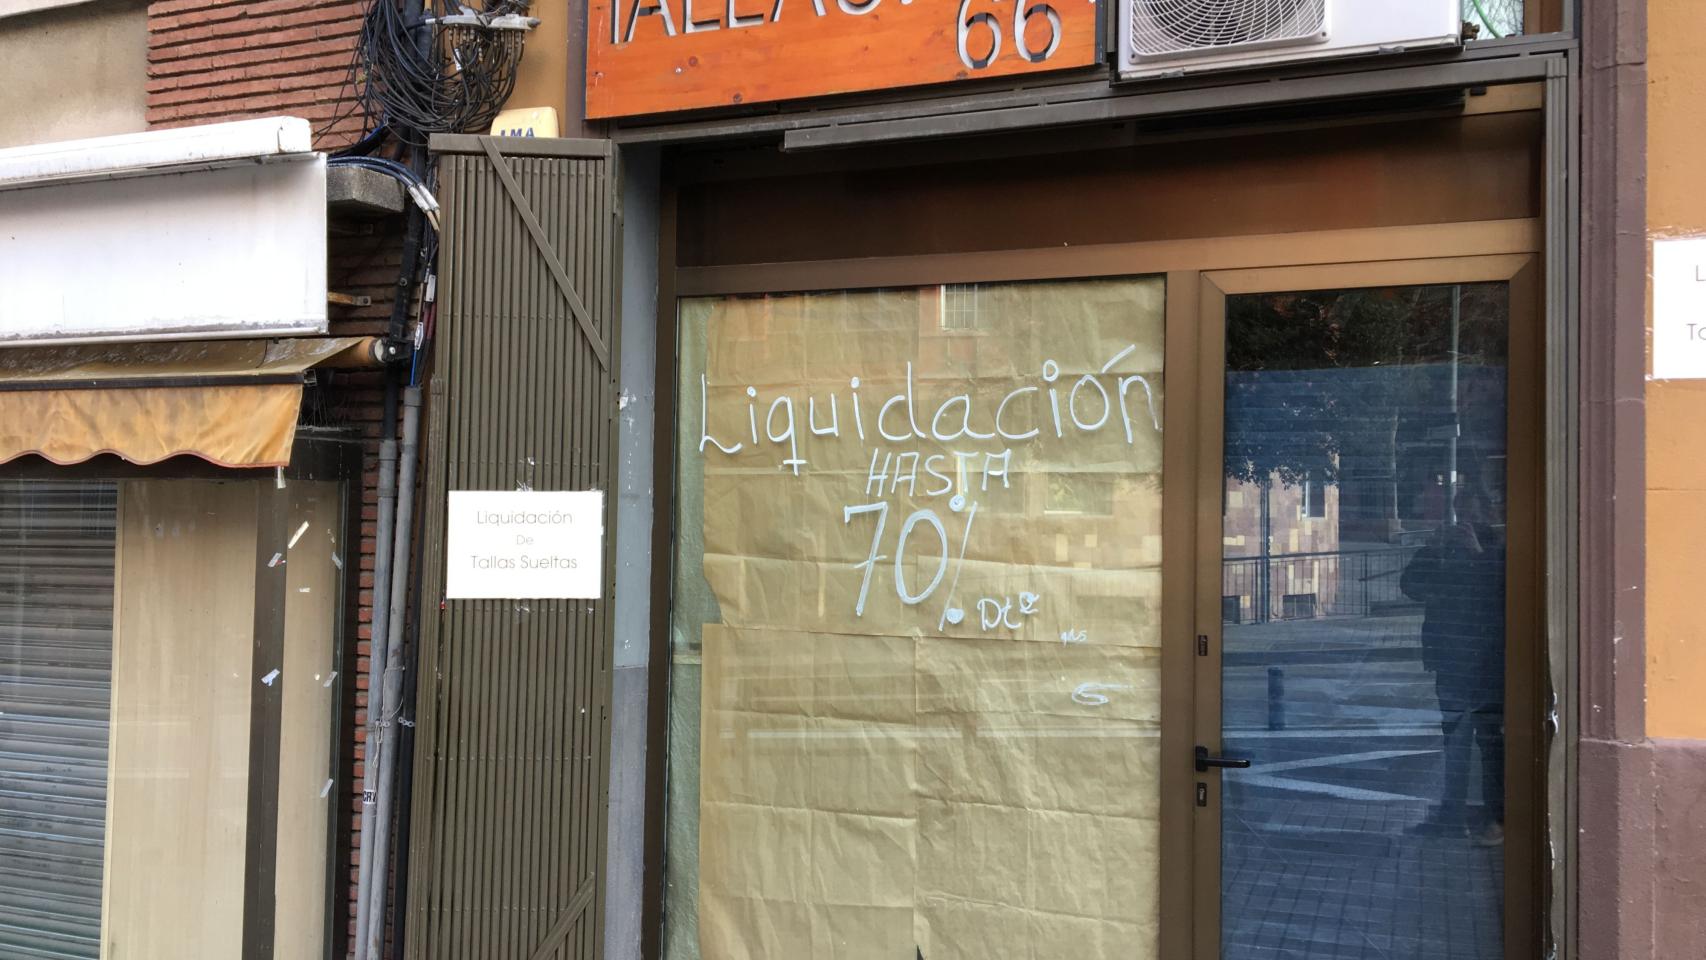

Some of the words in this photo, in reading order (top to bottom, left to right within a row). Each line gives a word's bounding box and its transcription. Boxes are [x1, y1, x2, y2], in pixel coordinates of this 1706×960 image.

[957, 0, 1061, 69] 66
[699, 344, 1162, 476] Liquidación
[866, 448, 1012, 497] HASTA
[477, 510, 573, 527] Liquidación
[516, 534, 534, 546] De
[471, 555, 516, 569] Tallas
[520, 555, 578, 569] Sueltas
